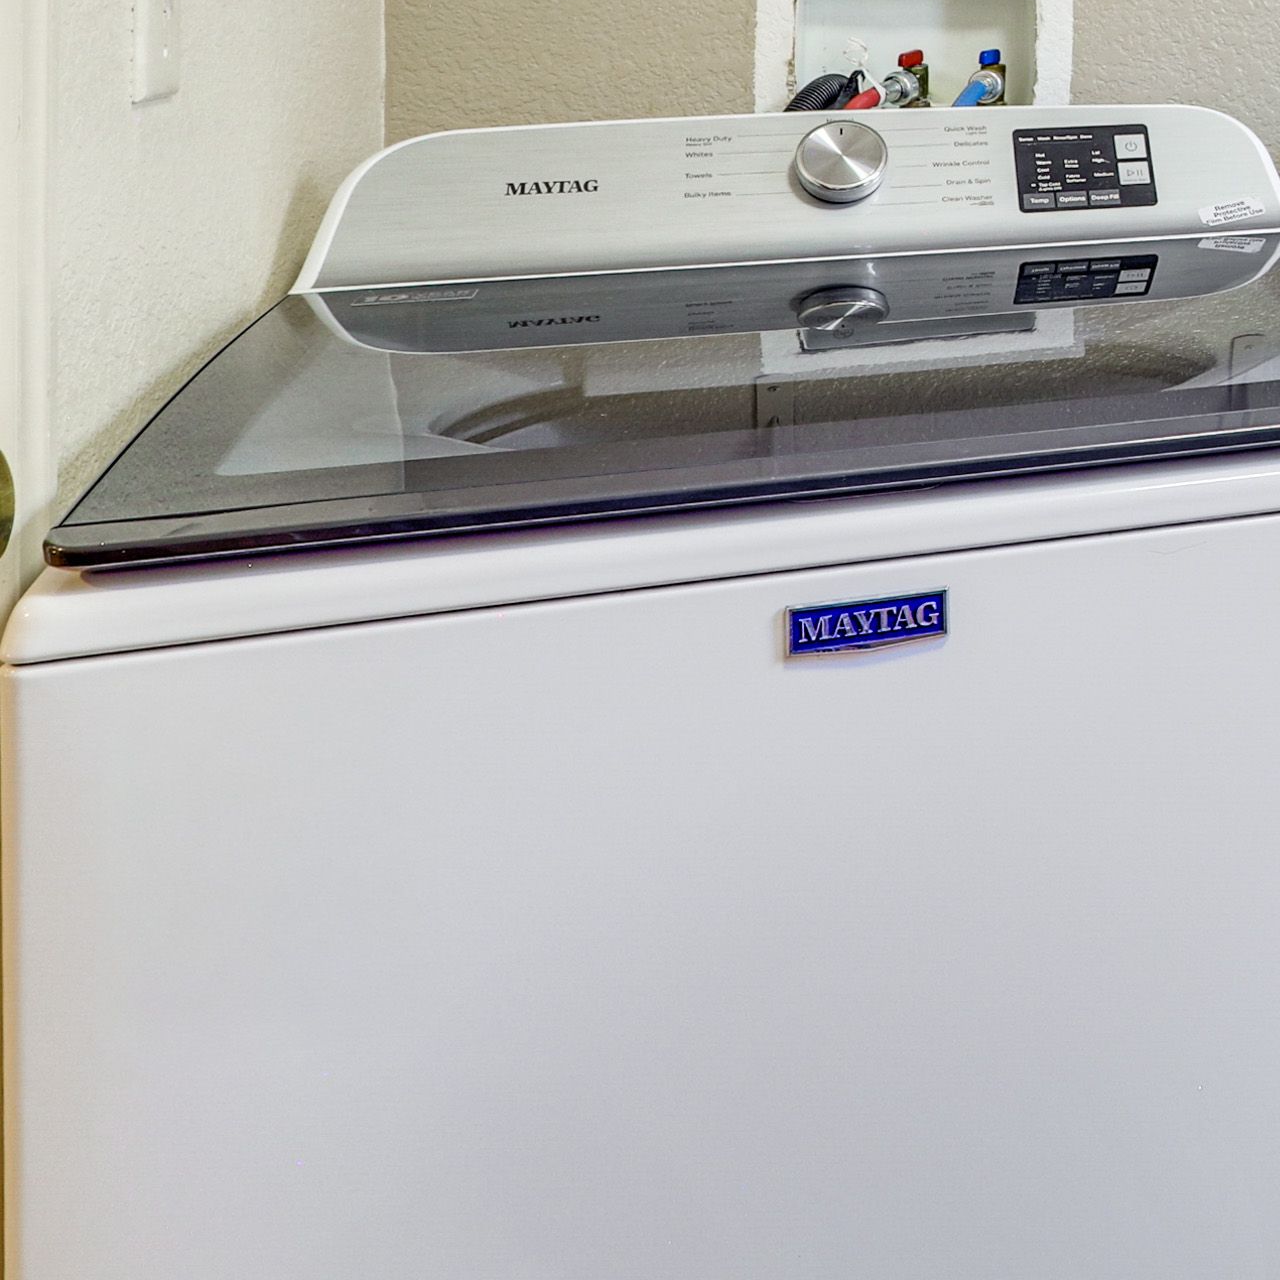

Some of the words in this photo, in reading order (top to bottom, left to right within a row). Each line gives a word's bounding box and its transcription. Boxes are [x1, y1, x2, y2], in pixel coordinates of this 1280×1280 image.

[685, 136, 711, 144] Heavy
[504, 179, 600, 196] MAYTAG
[1030, 197, 1050, 205] Temp
[1059, 195, 1086, 203] Options
[1090, 194, 1109, 202] Deep
[1214, 200, 1245, 211] Remove
[1213, 205, 1251, 218] Protective
[1223, 212, 1248, 221] Before
[798, 601, 940, 643] MAYTAG
